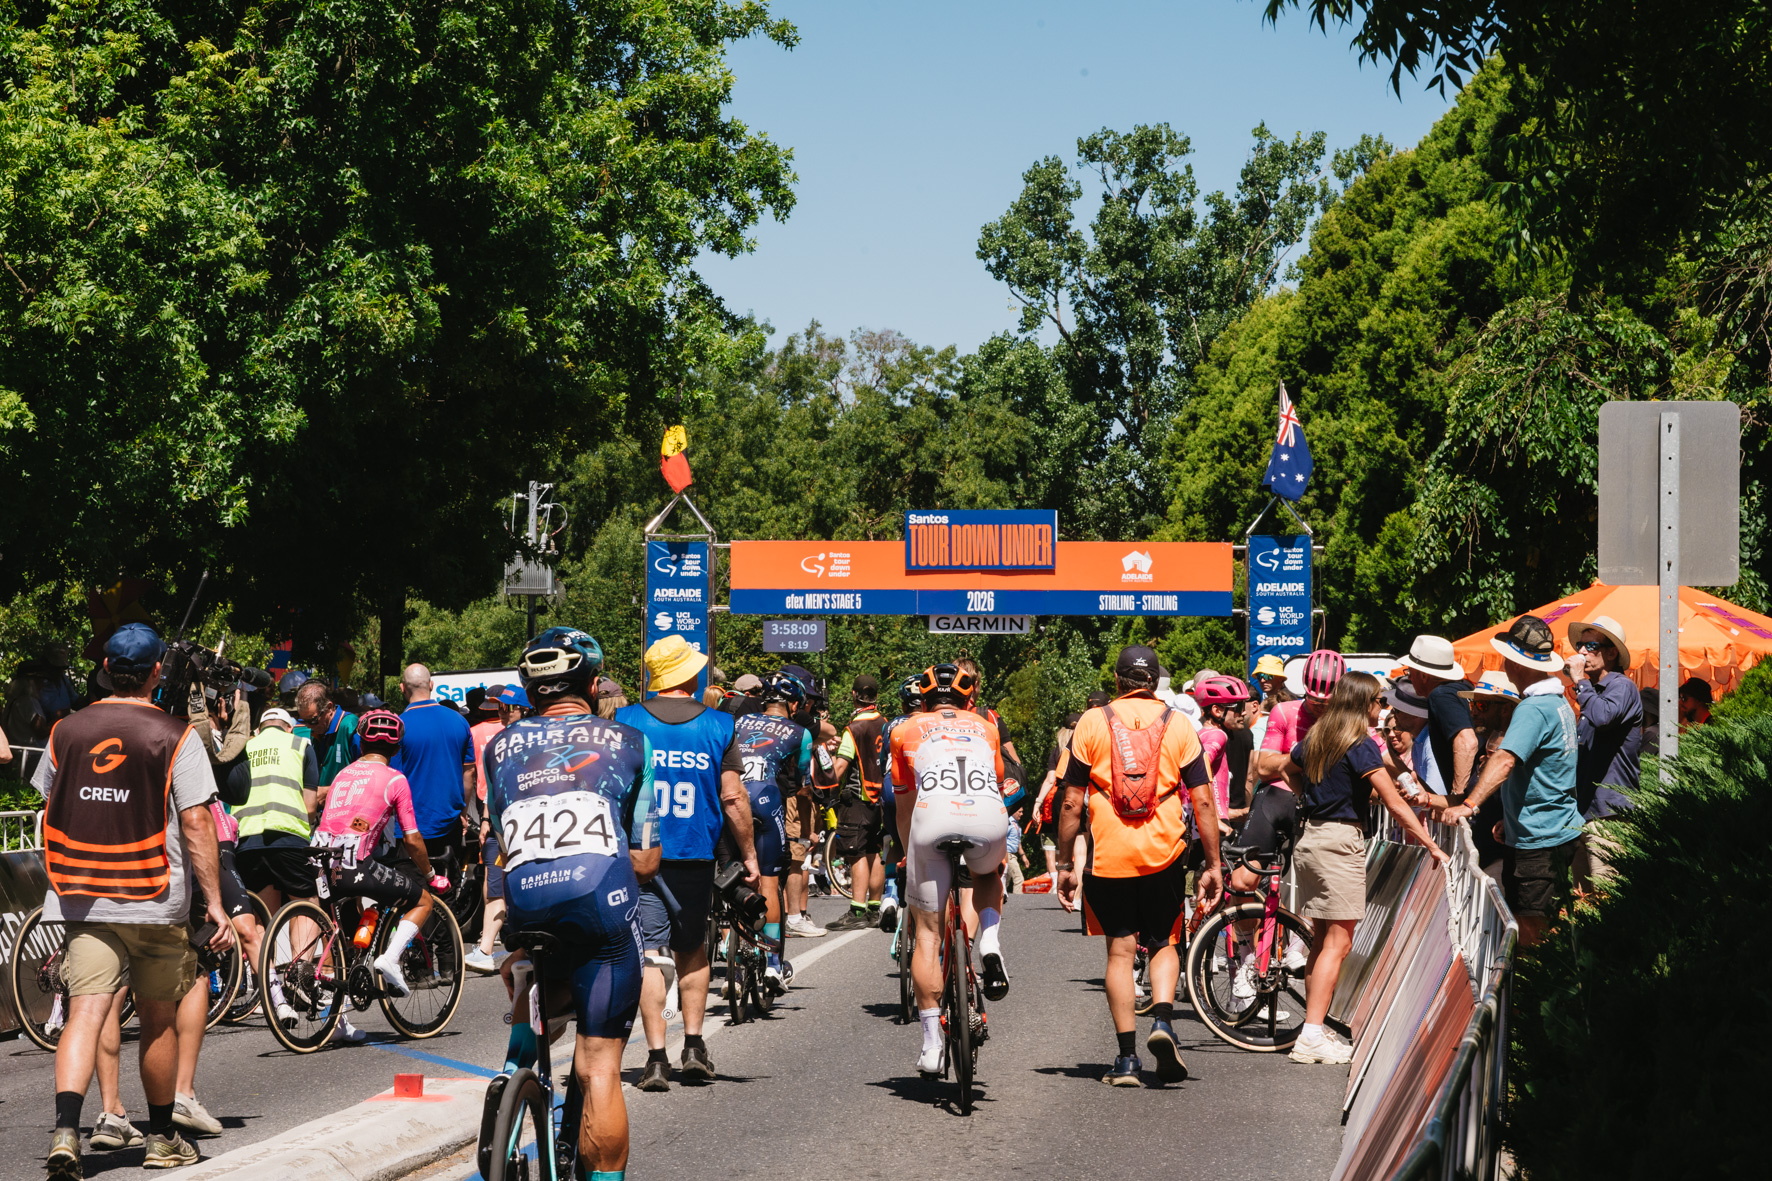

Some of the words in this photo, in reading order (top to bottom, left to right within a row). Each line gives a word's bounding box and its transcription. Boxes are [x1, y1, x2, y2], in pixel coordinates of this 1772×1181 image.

[908, 513, 949, 524] Santos
[908, 524, 949, 566] TOUR
[951, 524, 1000, 566] DOWN
[1001, 524, 1053, 566] UNDER
[653, 588, 702, 598] ADELAIDE
[1256, 583, 1305, 592] ADELAIDE
[785, 594, 805, 609] efex
[805, 594, 830, 609] MEN'S
[831, 594, 854, 609] STAGE
[855, 594, 862, 609] 5
[967, 591, 995, 612] 2026
[1099, 594, 1135, 611] STIRLING
[1142, 594, 1178, 611] STIRLING
[771, 623, 818, 635] 3:58:09
[935, 616, 1024, 631] GARMIN
[787, 640, 809, 649] 8:19
[1256, 634, 1305, 646] Santos
[530, 664, 557, 673] RUDY
[918, 719, 986, 735] INEOS
[494, 726, 623, 756] BAHRAIN
[1112, 721, 1138, 772] CAMELBAK
[248, 748, 279, 760] SPORTS
[495, 736, 622, 764] VICTORIOUS
[652, 750, 710, 770] RESS
[516, 767, 560, 784] Bapco
[518, 772, 576, 791] energies
[921, 768, 959, 792] 65
[967, 769, 999, 795] 65
[79, 786, 131, 803] CREW
[328, 777, 371, 810] EF
[504, 812, 551, 861] 24
[553, 809, 613, 849] 24
[521, 869, 571, 885] BAHRAIN
[521, 876, 571, 890] VICTORIOUS
